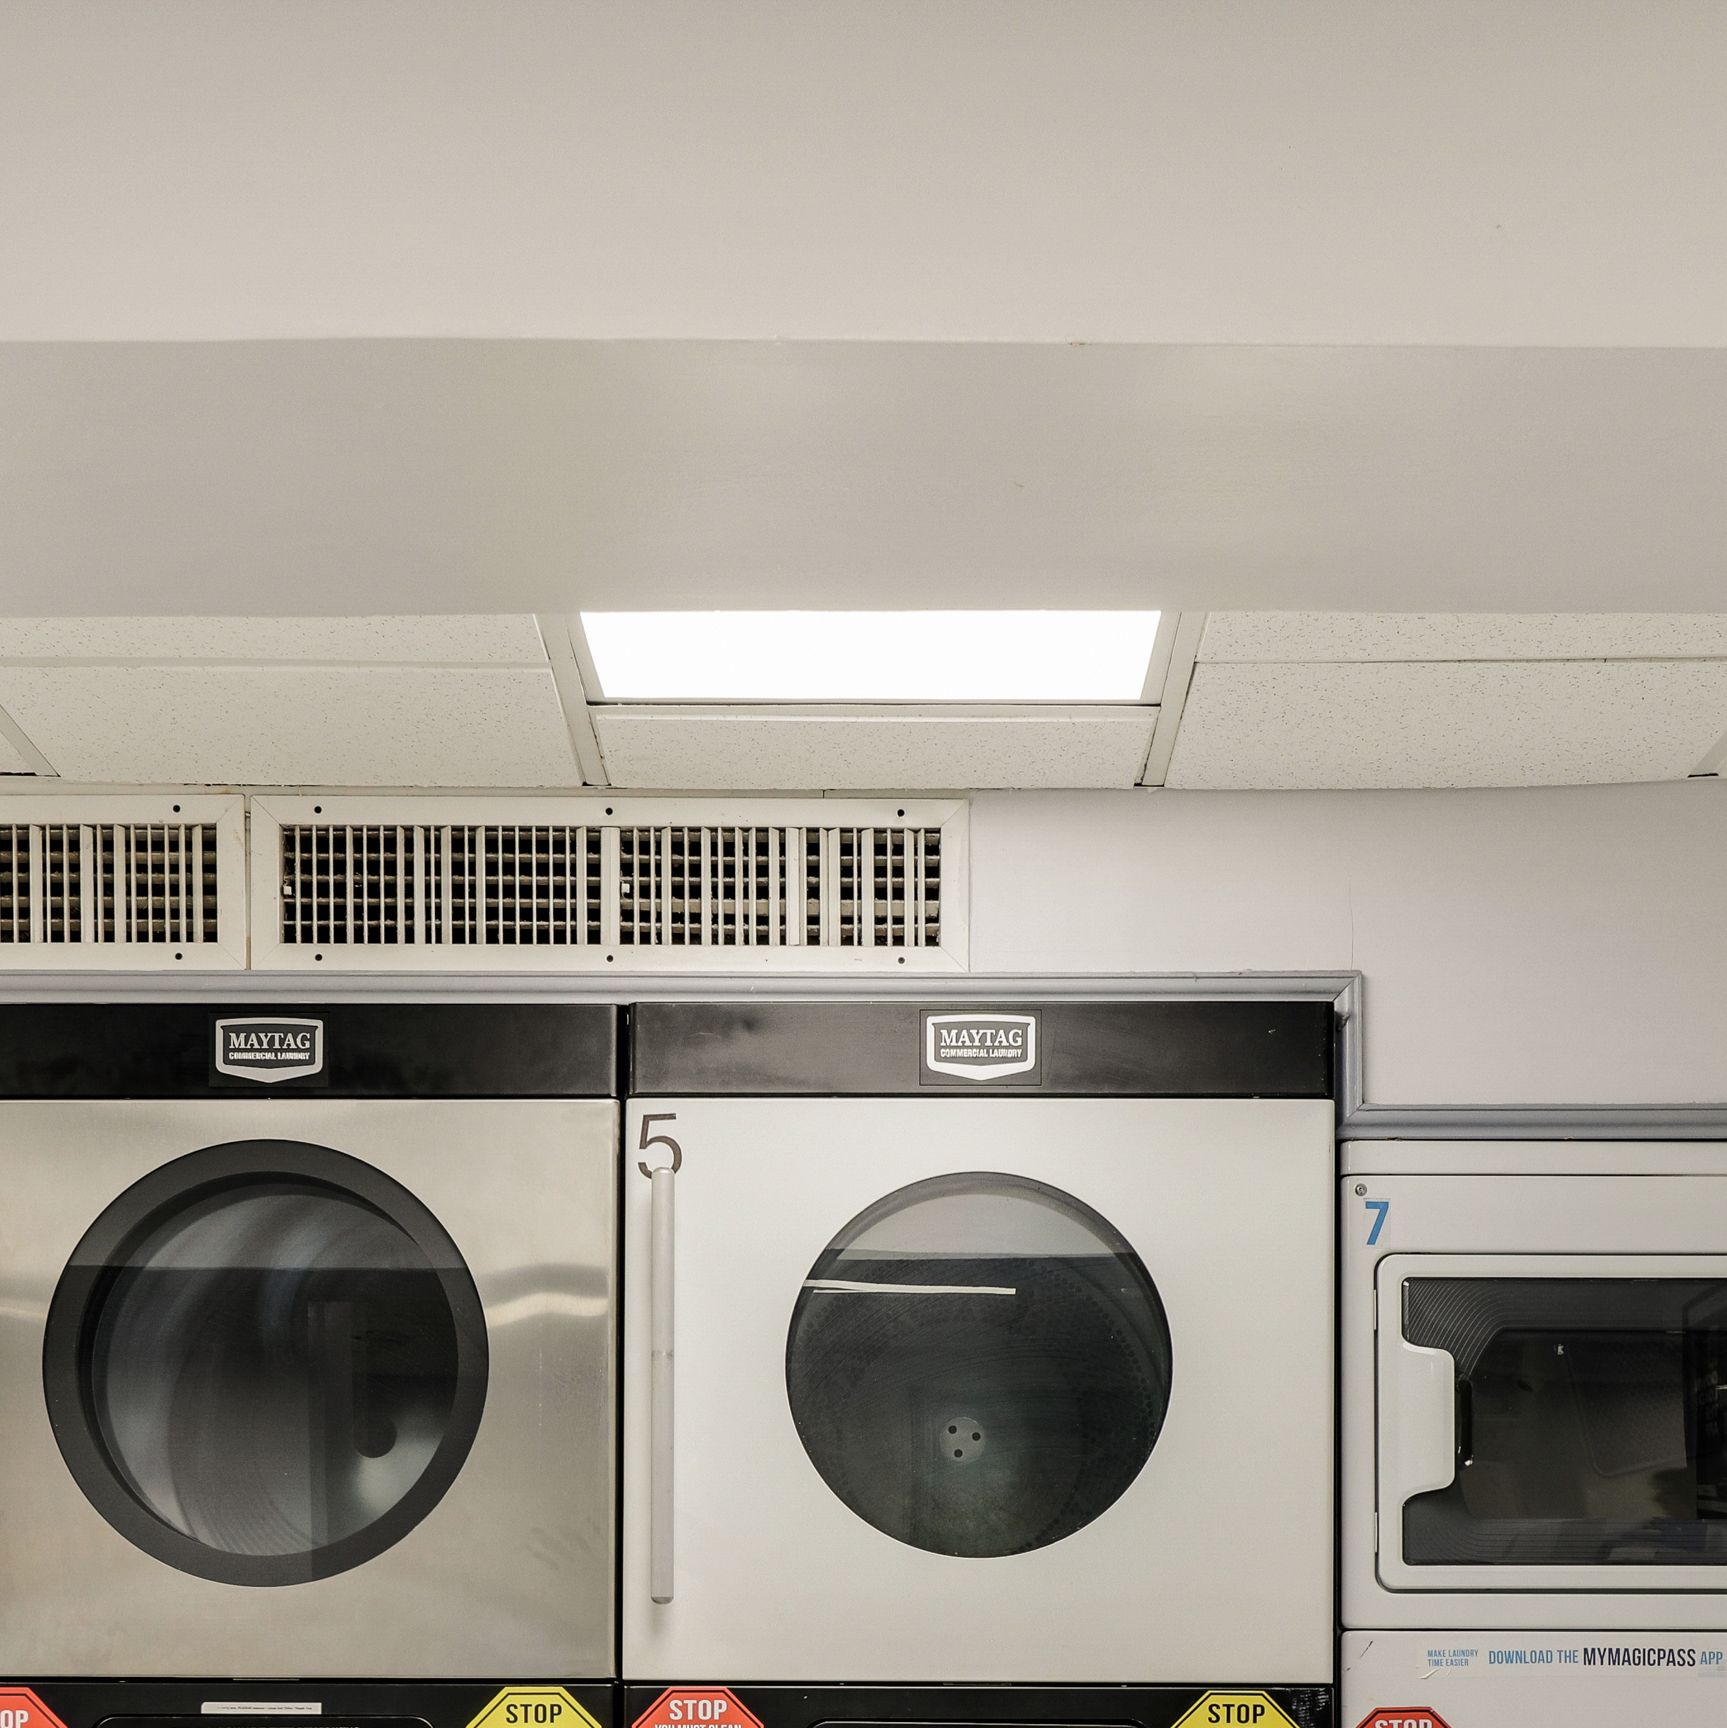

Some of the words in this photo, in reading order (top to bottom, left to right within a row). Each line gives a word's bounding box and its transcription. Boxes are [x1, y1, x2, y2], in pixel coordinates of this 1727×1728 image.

[228, 1032, 311, 1049] MAYTAG
[939, 1029, 1023, 1047] MAYTAG
[228, 1052, 277, 1061] COMMERCIAL
[277, 1052, 311, 1061] LAUNDRY
[940, 1048, 989, 1058] COMMERCIAL
[989, 1048, 1023, 1058] LAUNDRY
[638, 1112, 683, 1180] 5
[1364, 1201, 1390, 1246] 7
[1427, 1649, 1447, 1658] MAKE
[1448, 1649, 1479, 1658] LAUNDRY
[1427, 1658, 1444, 1667] TIME
[1445, 1658, 1470, 1667] EASIER
[1488, 1649, 1554, 1665] DOWNLOAD
[1556, 1649, 1580, 1664] THE
[1583, 1647, 1697, 1668] MYMAGICPASS
[1699, 1651, 1724, 1665] APP
[505, 1703, 563, 1724] STOP
[669, 1699, 728, 1721] STOP
[1207, 1703, 1266, 1725] STOP
